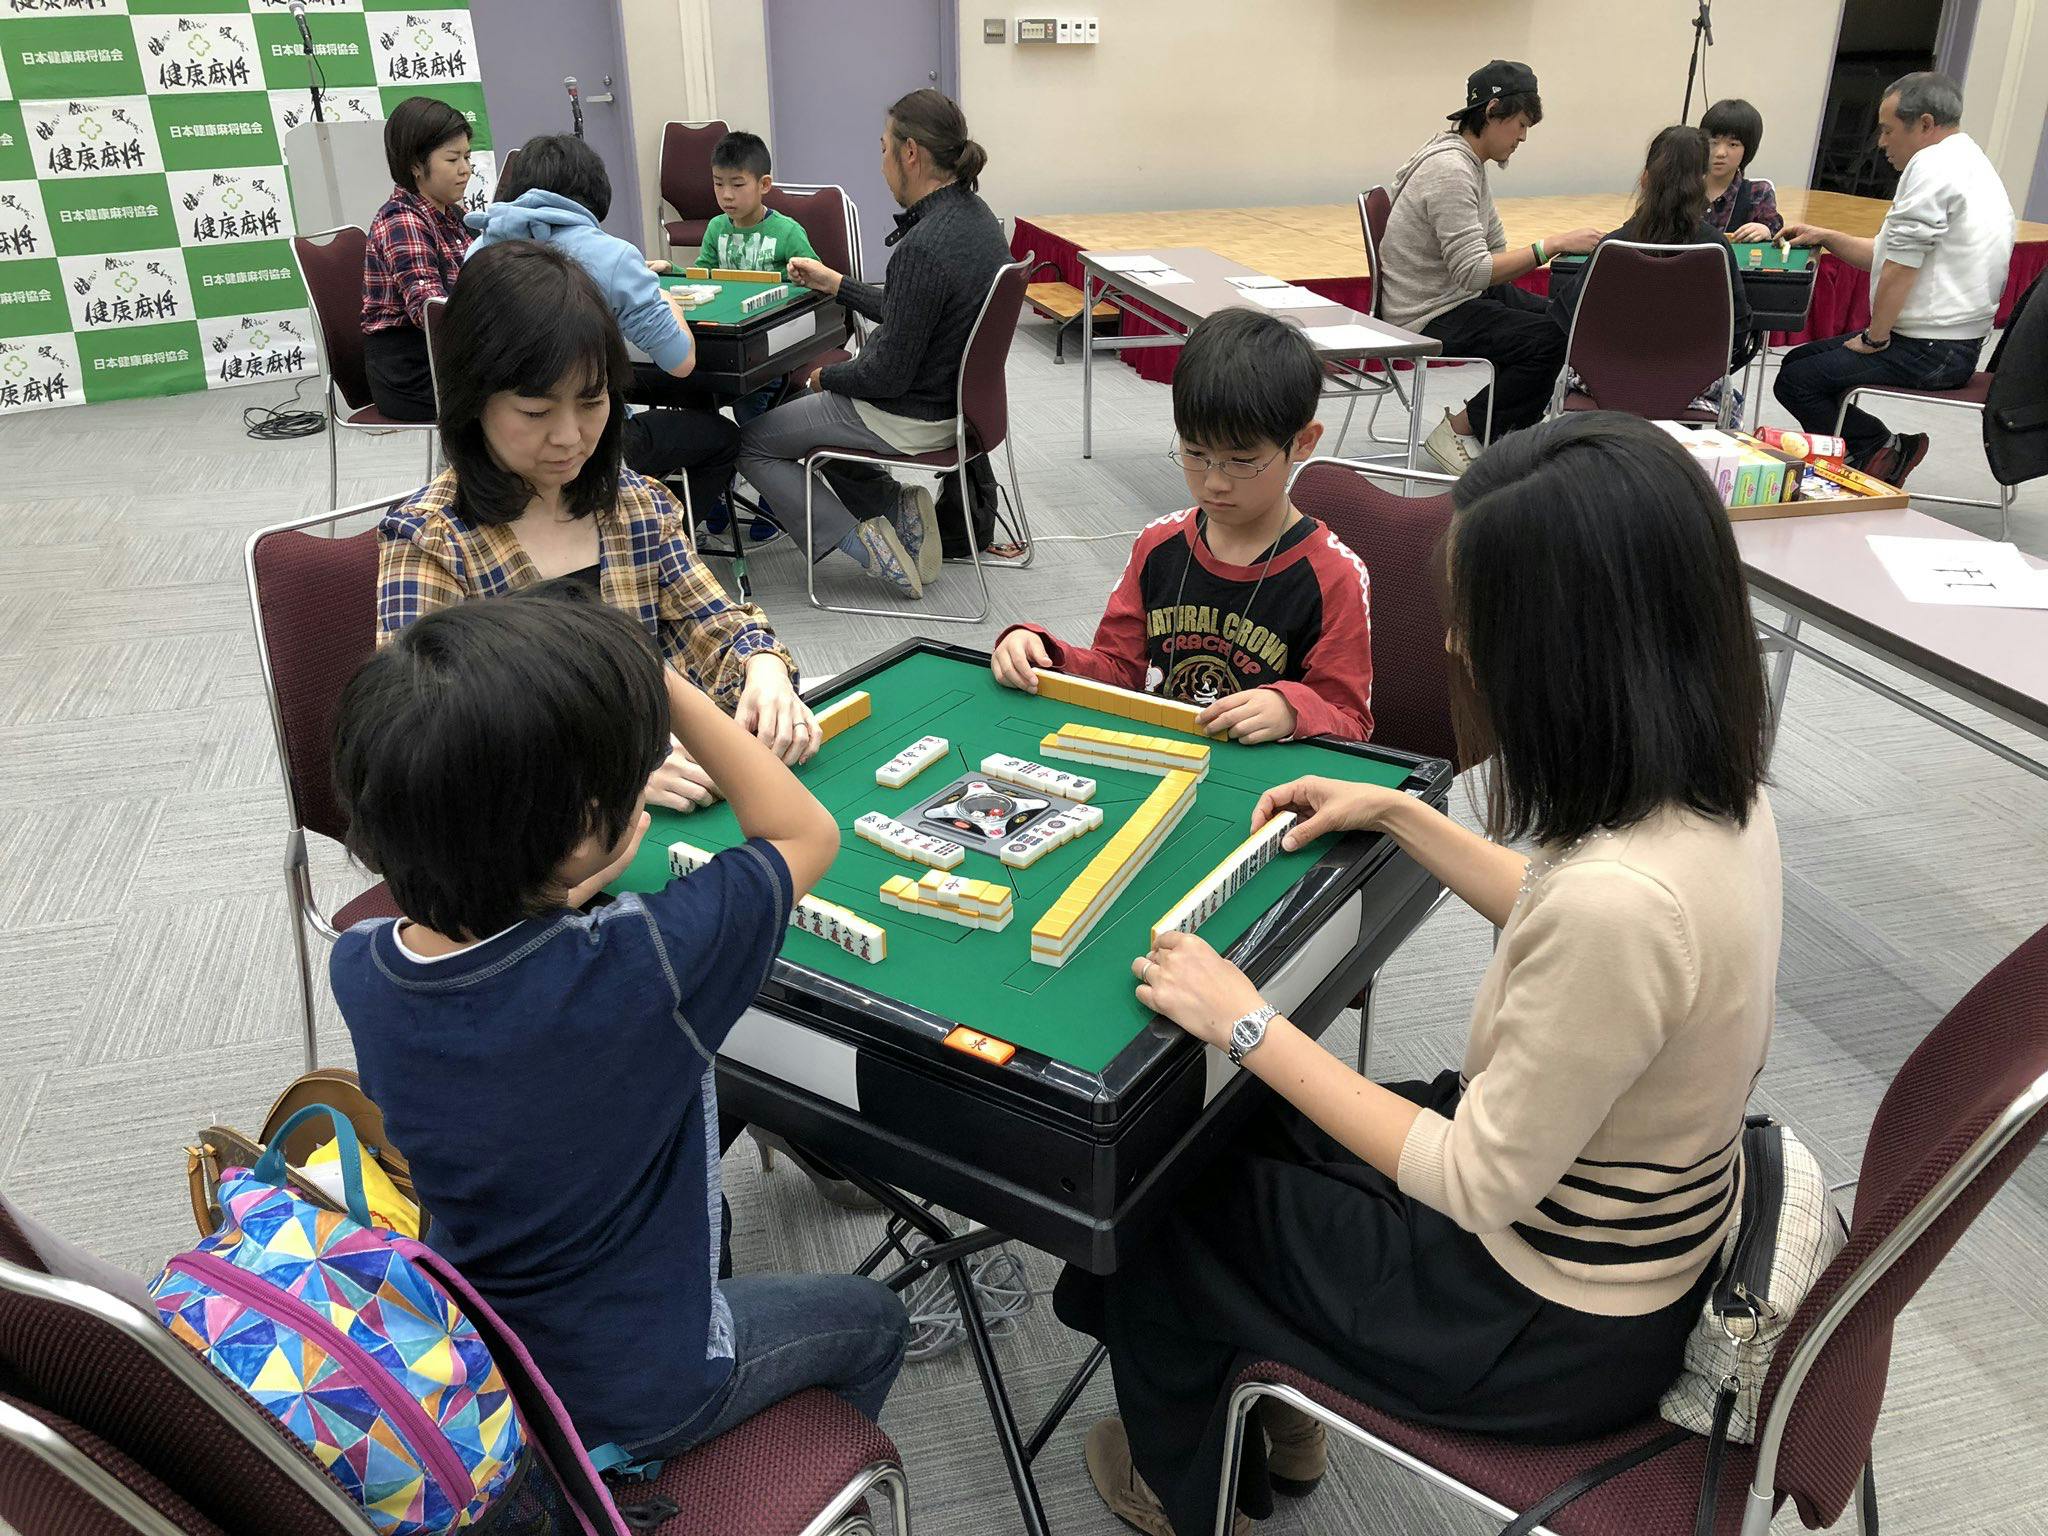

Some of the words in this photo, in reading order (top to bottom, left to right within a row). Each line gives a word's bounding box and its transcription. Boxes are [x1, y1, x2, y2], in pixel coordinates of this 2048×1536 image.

[22, 49, 124, 65] 日本健康麻将協会
[389, 49, 467, 81] 健康麻将
[160, 56, 250, 89] 健康麻将
[170, 122, 263, 137] 日本健康麻将協会
[49, 138, 145, 174] 健康麻将
[60, 205, 159, 223] 日本健康麻将協会
[193, 207, 281, 242] 健康麻将
[203, 268, 291, 287] 日本健康麻将協会
[85, 289, 178, 326] 健康麻将
[94, 349, 189, 370] 日本健康麻将協会
[220, 346, 306, 382] 健康麻将
[1232, 650, 1262, 675] UP
